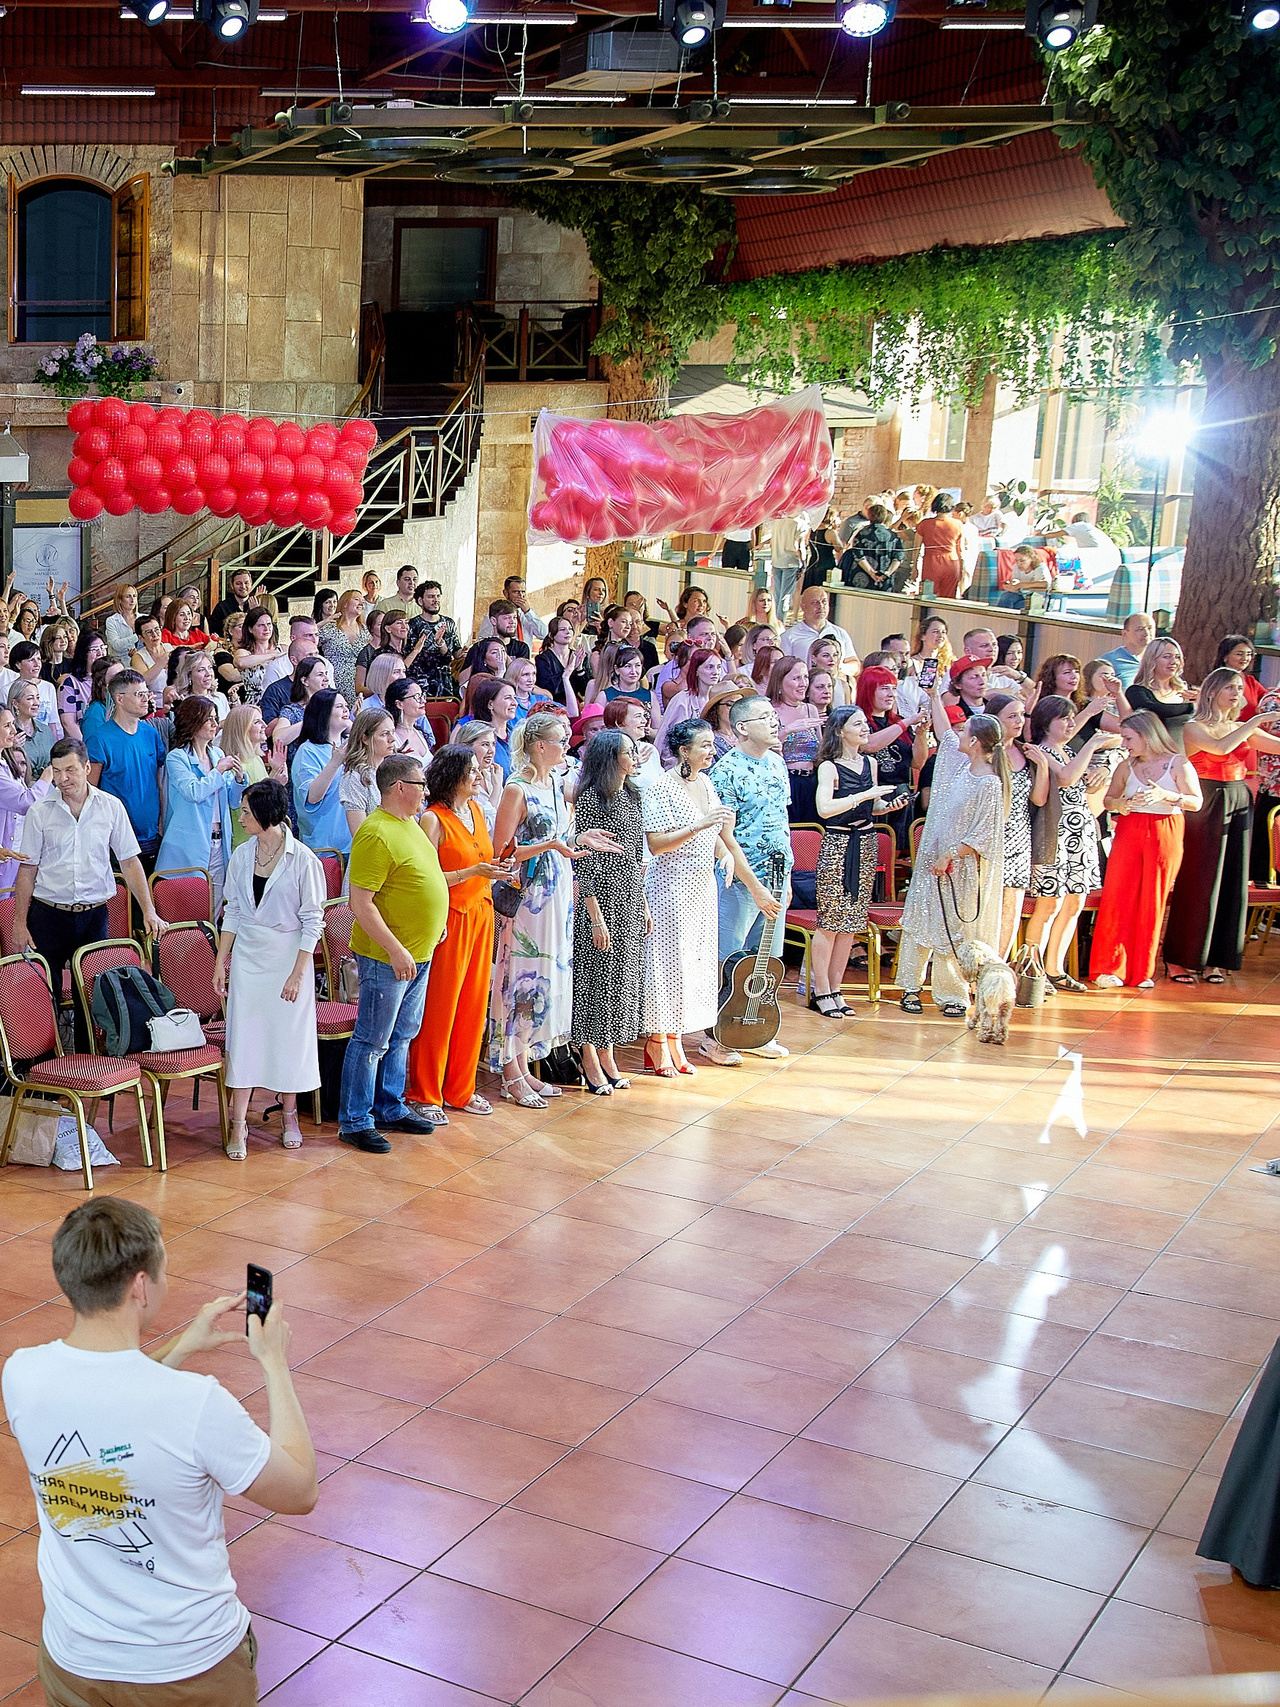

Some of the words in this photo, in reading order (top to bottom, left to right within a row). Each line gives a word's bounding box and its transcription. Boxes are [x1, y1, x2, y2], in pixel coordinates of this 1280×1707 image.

[39, 1493, 88, 1513] ЕНЯЕМ
[91, 1504, 148, 1520] ЖИЗНЬ
[68, 1483, 156, 1508] ПРИВЫЧКИ
